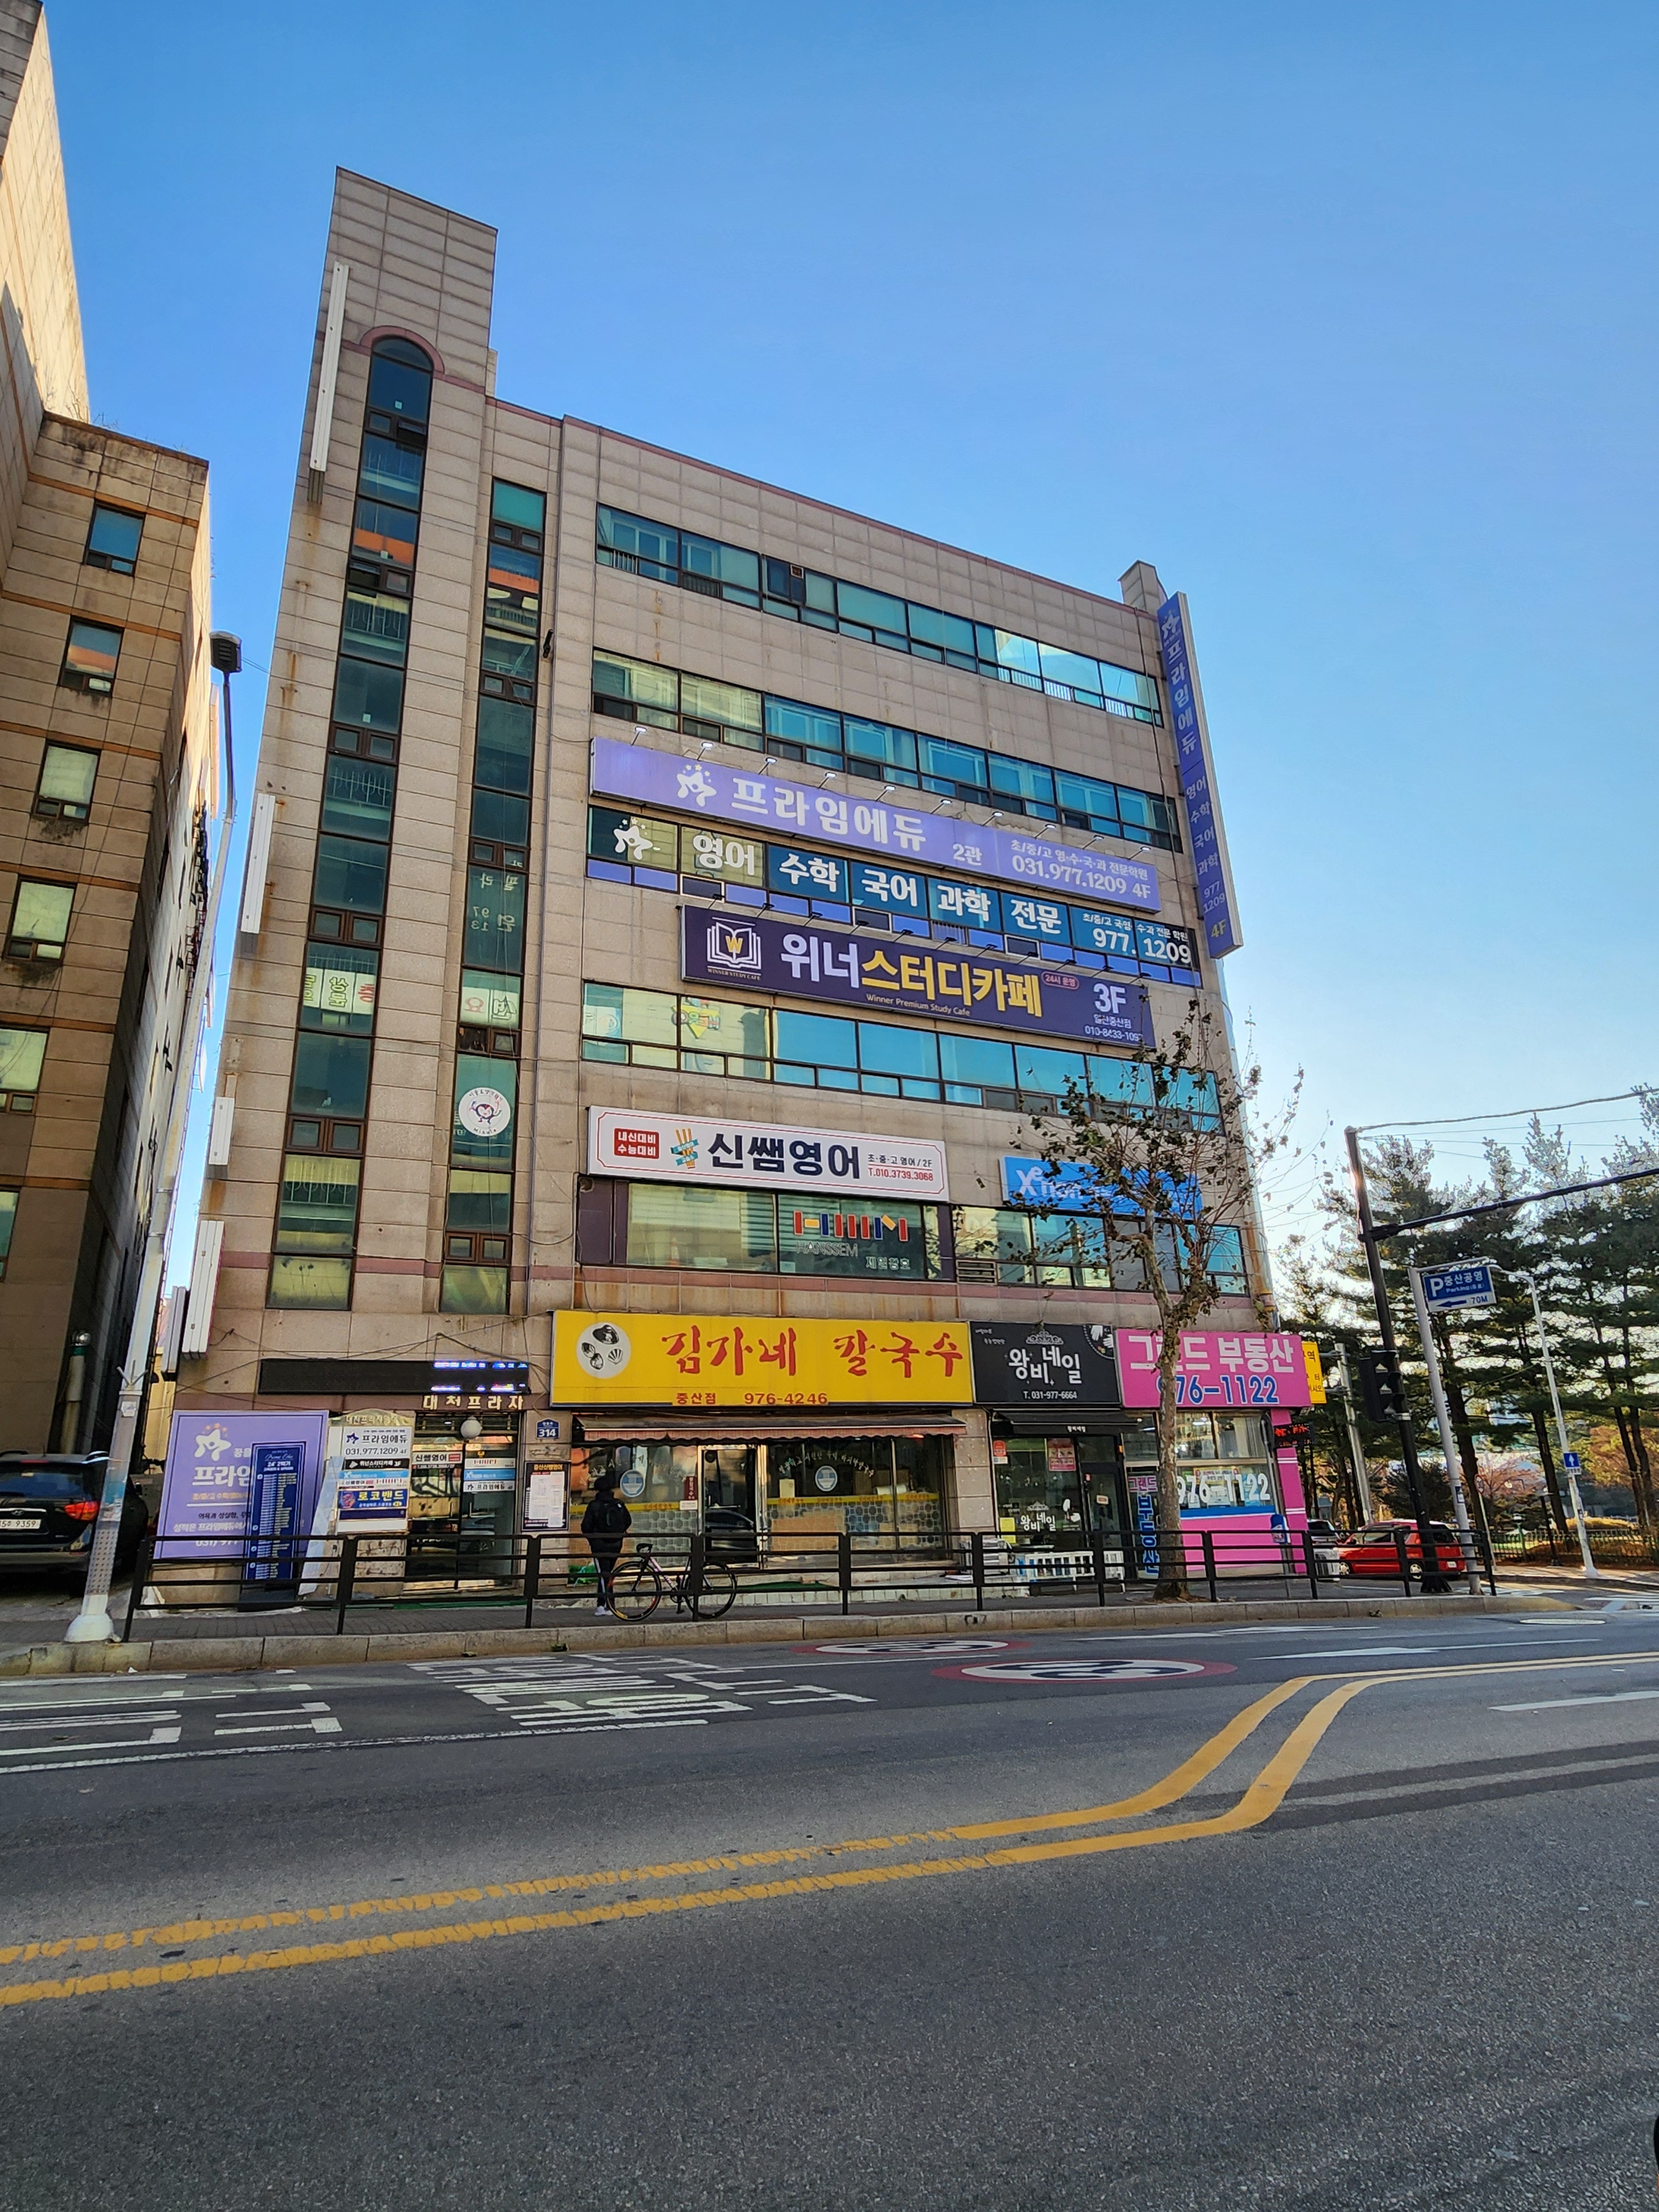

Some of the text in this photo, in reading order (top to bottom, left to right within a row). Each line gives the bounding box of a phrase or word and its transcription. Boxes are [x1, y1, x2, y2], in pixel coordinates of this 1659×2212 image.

[1166, 639, 1197, 755] 프라임에듀
[1185, 775, 1207, 800] 영어
[731, 777, 983, 866] 프라임에듀 2관
[1190, 800, 1211, 824] 수학
[1194, 826, 1215, 848] 국어
[1109, 861, 1149, 881] 전문학원
[1197, 853, 1219, 876] 과학
[692, 834, 1062, 935] 영어 수학 국어 과학 전문
[1012, 855, 1151, 899] 031.977.1209 4F
[1203, 880, 1220, 899] 977
[1203, 892, 1226, 914] 1209
[1156, 927, 1171, 939] 전문
[1172, 930, 1188, 942] 학원
[1211, 919, 1227, 938] 4F
[725, 935, 743, 954] W
[1143, 938, 1191, 964] 1209
[781, 933, 1042, 1018] 위너스터디카페
[866, 993, 971, 1016] Winner Premium Study Cafe
[1093, 983, 1126, 1014] 3F
[617, 1131, 656, 1144] 내신대비
[617, 1144, 656, 1156] 수능대비
[707, 1132, 860, 1180] 신쌤영어
[900, 1156, 915, 1166] 영어
[868, 1167, 933, 1181] T.010.3739.3068
[796, 1241, 858, 1257] HANSSEM
[865, 1256, 911, 1270] 제일창호
[1430, 1277, 1444, 1297] P
[1444, 1270, 1483, 1286] 중산공영
[1471, 1295, 1488, 1304] 70M
[661, 1324, 964, 1378] 김가네 칼국수
[1218, 1337, 1294, 1373] 부동산
[676, 1392, 828, 1406] 중산점 976-4246
[361, 1434, 408, 1444] 프라임에듀
[538, 1428, 556, 1437] 314
[345, 1447, 399, 1455] 031.977.1209
[415, 1454, 447, 1462] 신쌤영어
[1128, 1475, 1158, 1493] 그랜드
[1176, 1473, 1271, 1505] 976-1122
[357, 1490, 405, 1501] 로코밴드
